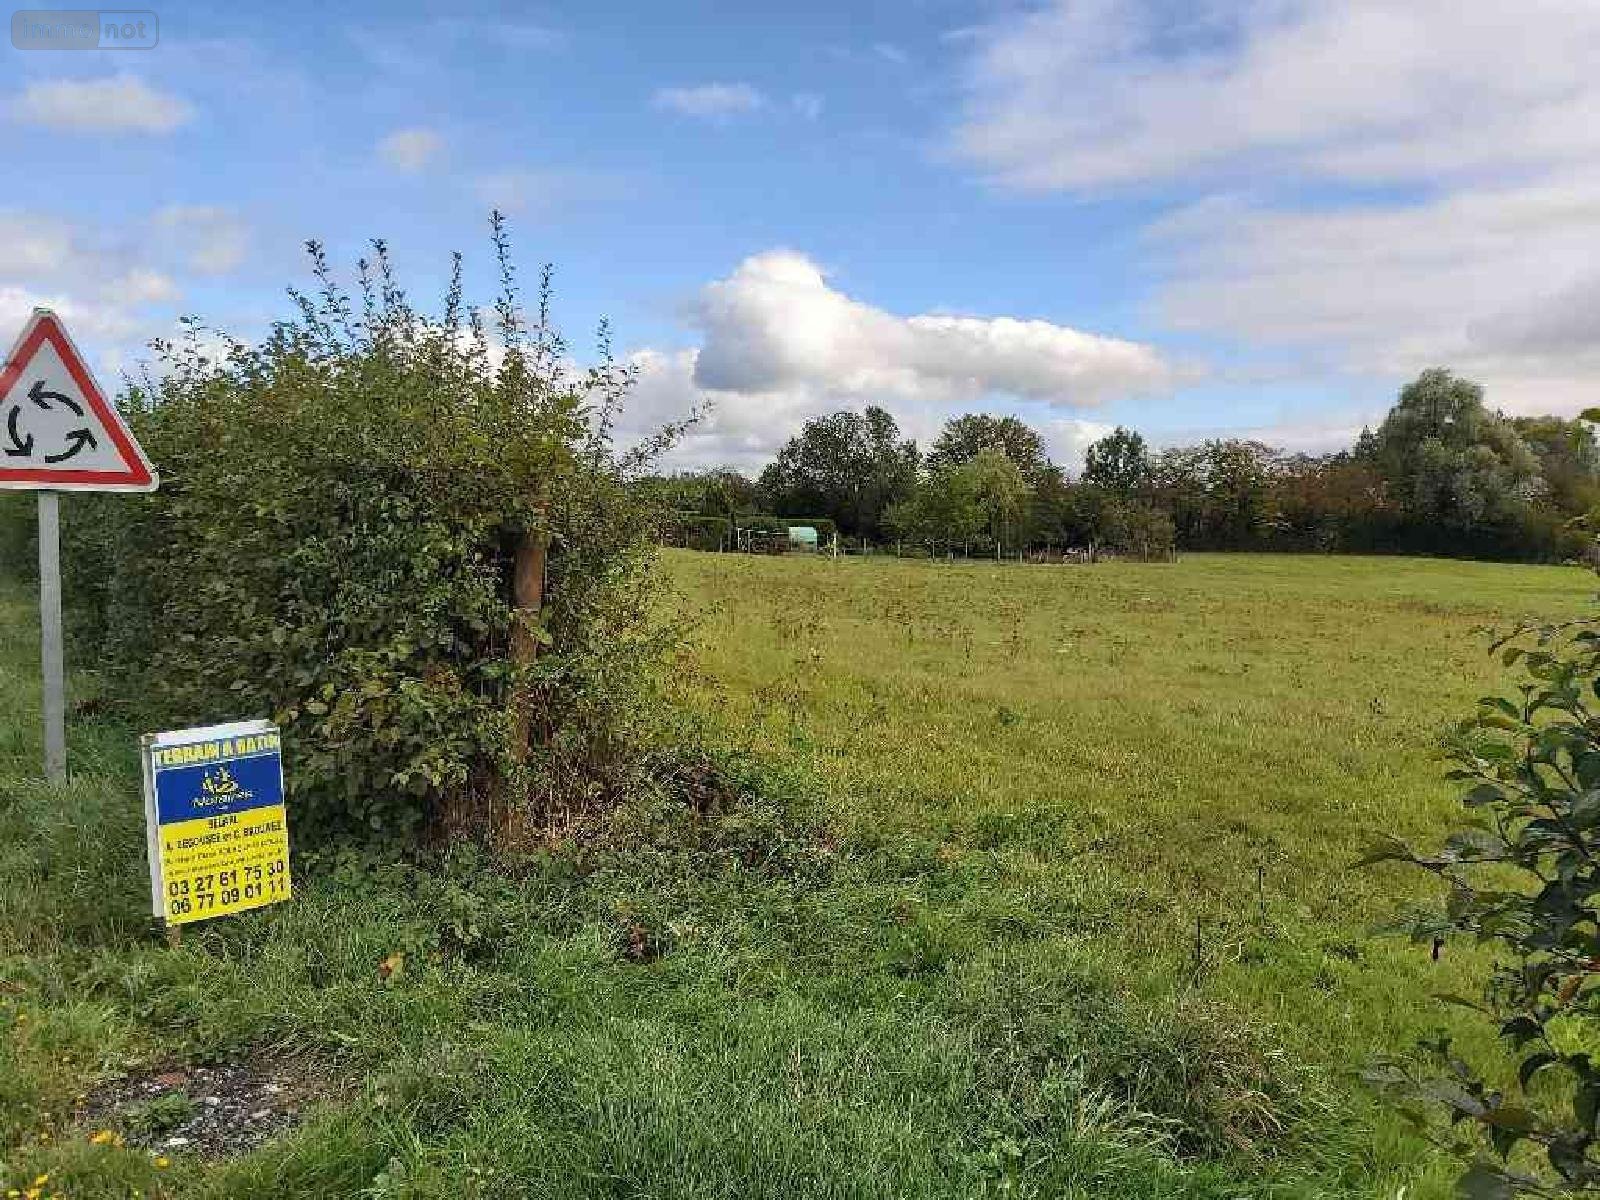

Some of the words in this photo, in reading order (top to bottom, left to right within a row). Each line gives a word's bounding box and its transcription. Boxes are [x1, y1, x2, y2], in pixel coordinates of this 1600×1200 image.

[169, 880, 189, 898] 03
[194, 874, 214, 892] 27
[219, 869, 237, 887] 61
[243, 864, 262, 881] 75
[266, 860, 284, 876] 30
[171, 897, 191, 915] 06
[196, 893, 215, 910] 77
[221, 888, 240, 905] 09
[244, 882, 262, 899] 01
[268, 877, 284, 893] 11
